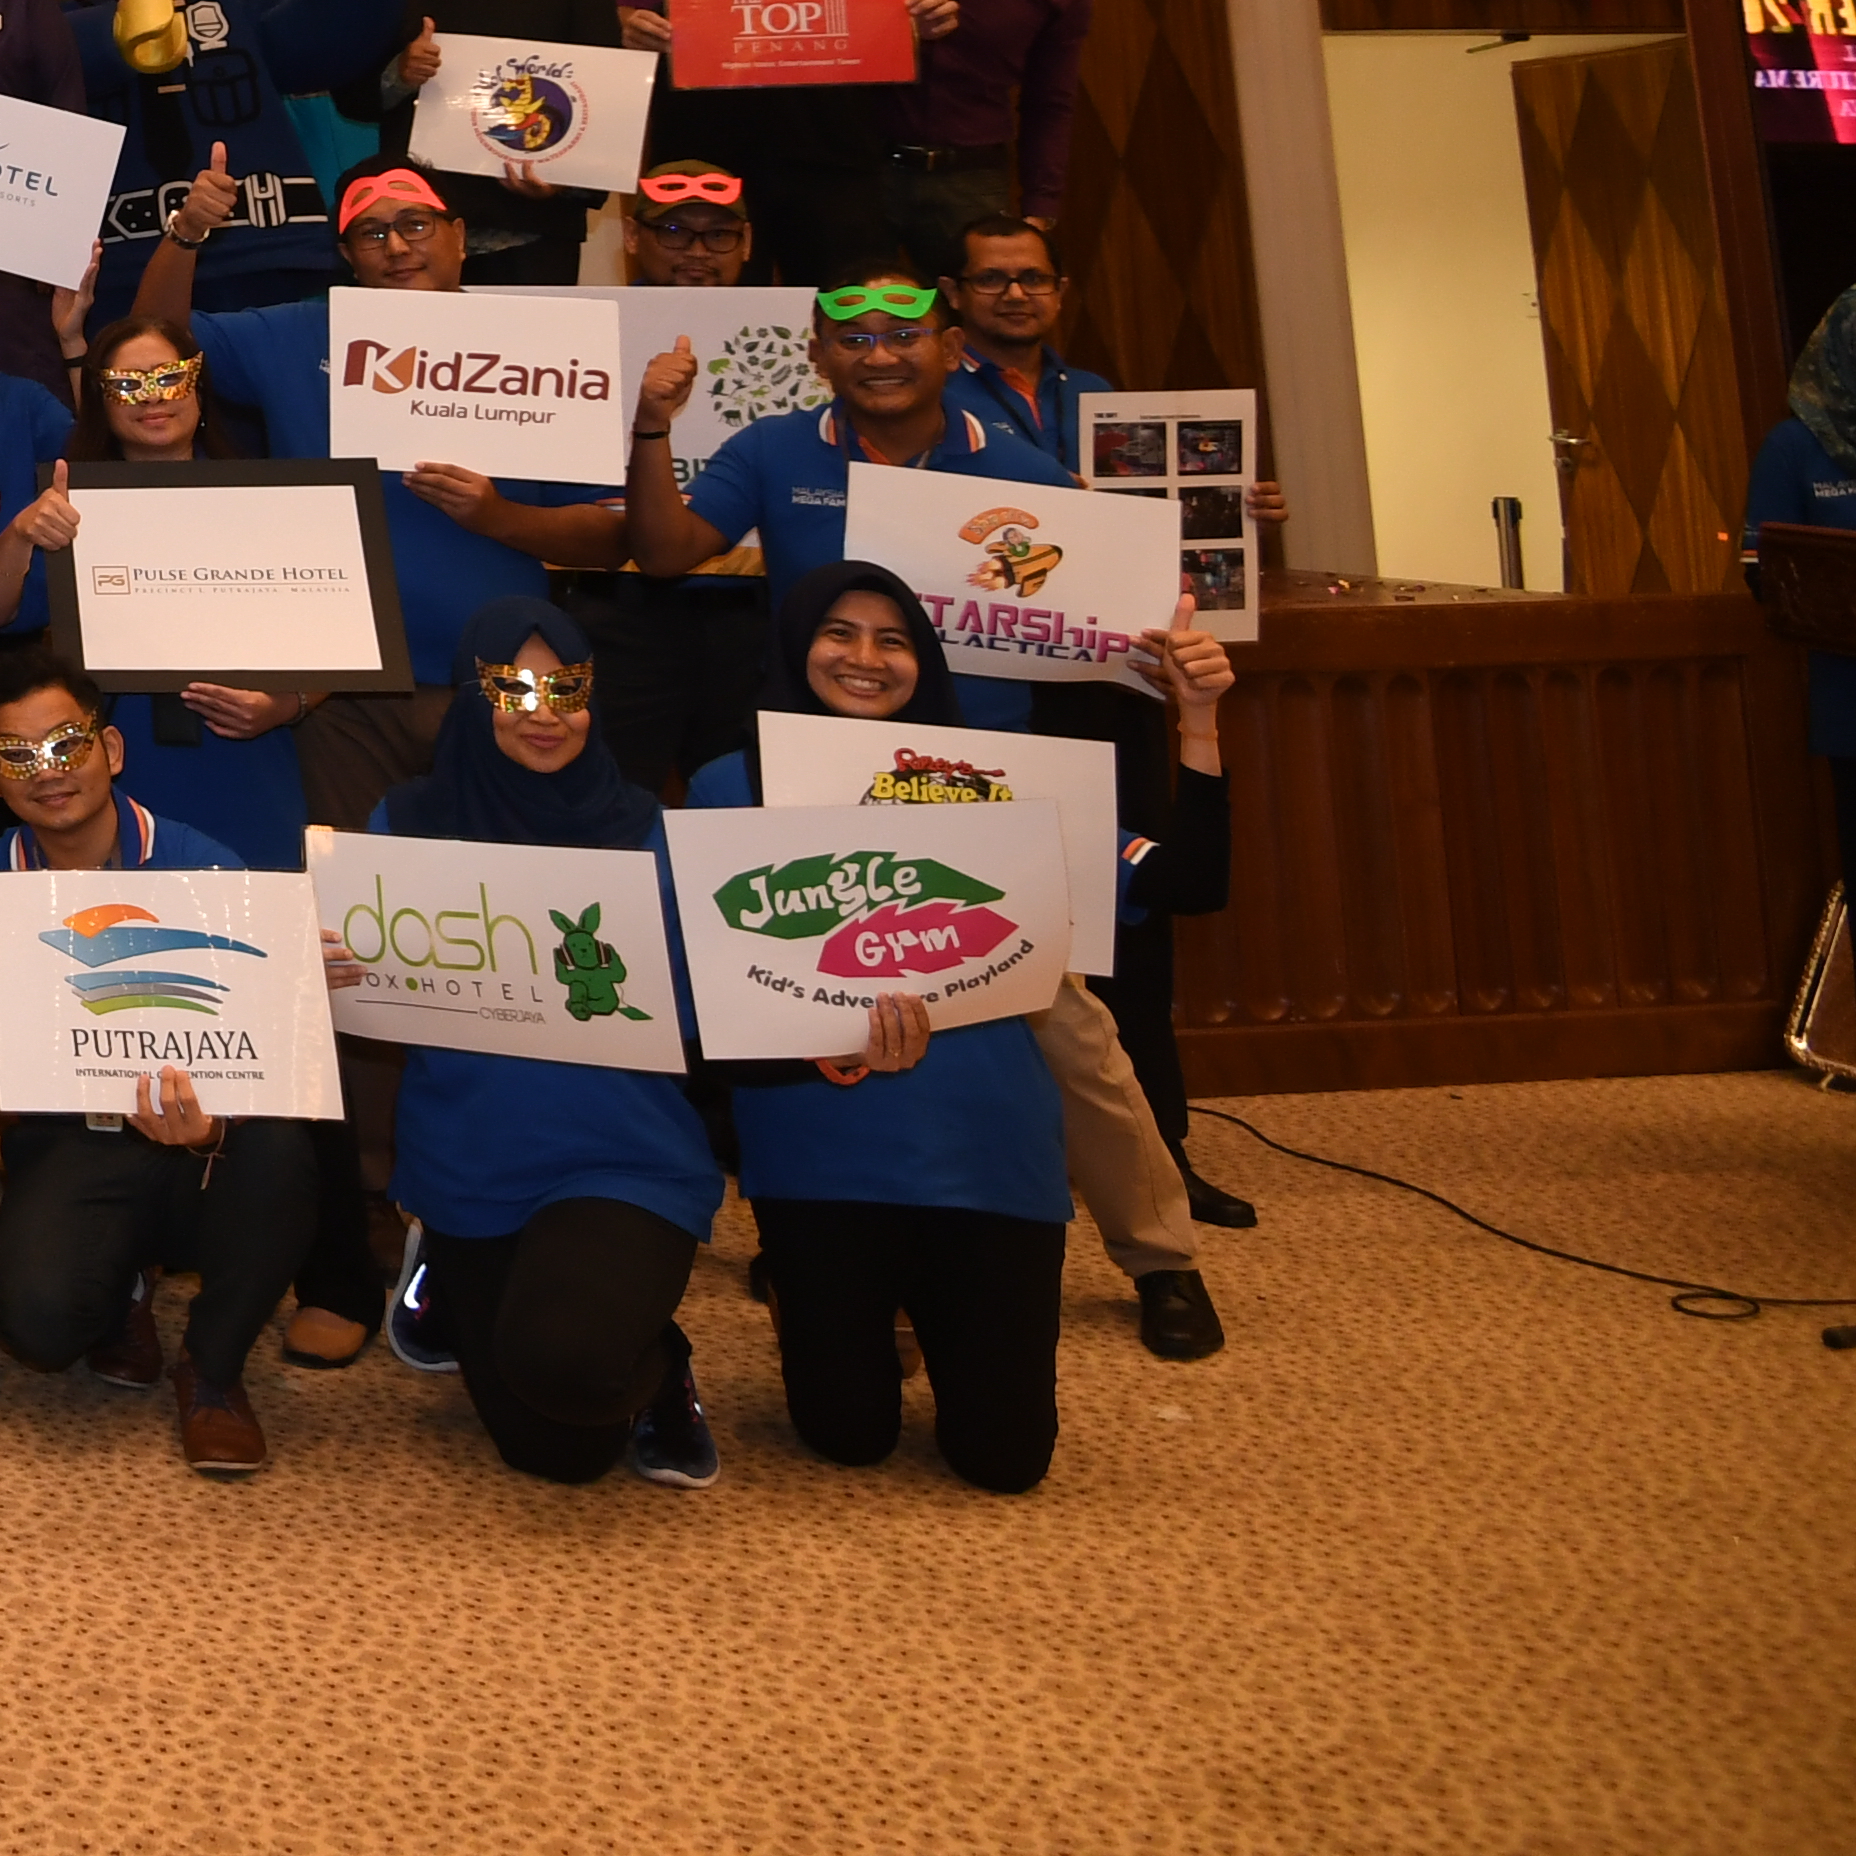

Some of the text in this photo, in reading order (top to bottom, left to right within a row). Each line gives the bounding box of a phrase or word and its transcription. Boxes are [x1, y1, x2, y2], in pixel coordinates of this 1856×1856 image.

[730, 1, 823, 35] TOP
[733, 39, 848, 54] PENANG
[343, 339, 610, 401] KidZania
[409, 400, 556, 426] Kuala Lumpur
[133, 566, 349, 582] PULSE GRANDE HOTEL
[870, 771, 978, 804] Believe
[343, 873, 539, 976] dash
[747, 963, 806, 1000] Kid's
[945, 939, 1035, 998] Playland
[364, 971, 544, 1003] OX HOTEL
[479, 1006, 546, 1025] CYBERJAYA
[70, 1028, 260, 1067] PUTRAJAYA
[226, 1070, 265, 1081] CENTRE
